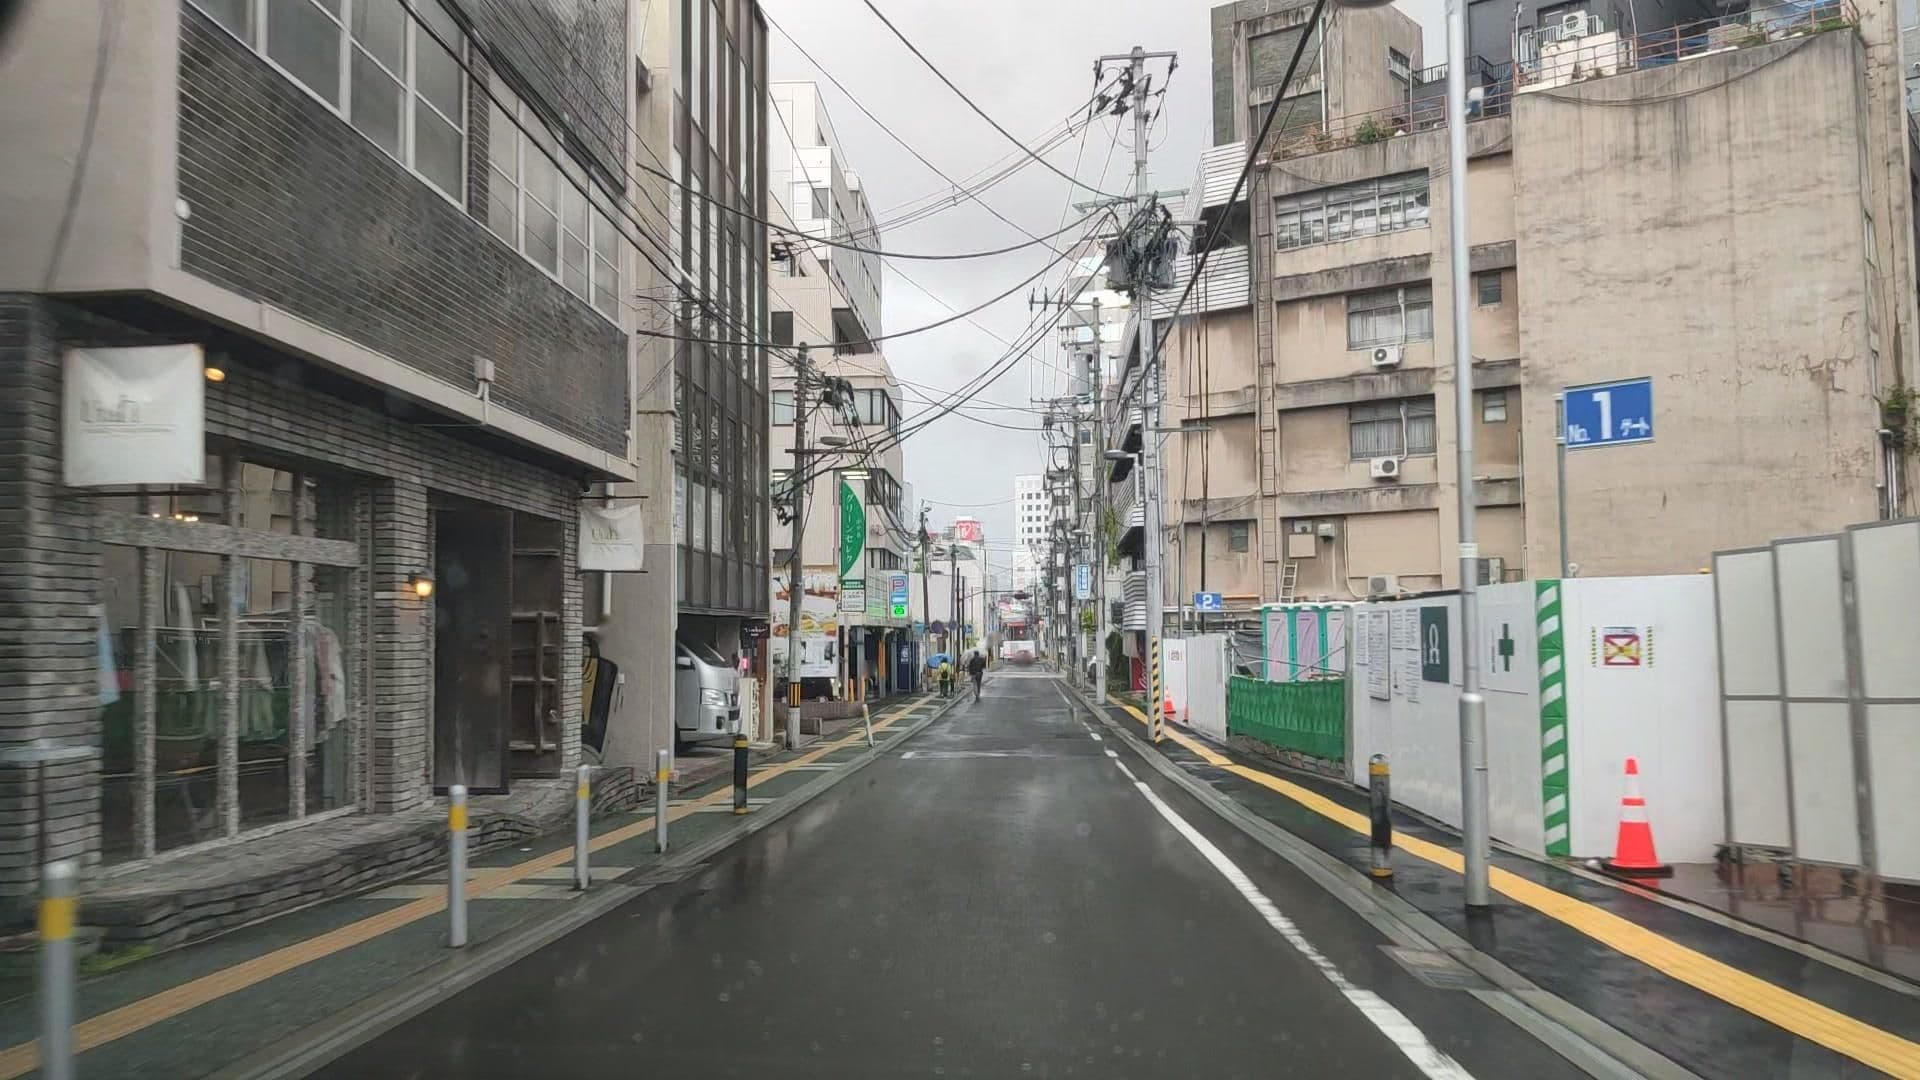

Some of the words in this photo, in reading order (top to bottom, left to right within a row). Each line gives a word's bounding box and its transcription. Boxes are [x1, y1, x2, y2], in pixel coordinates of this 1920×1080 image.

[1592, 391, 1612, 439] 1
[892, 578, 905, 592] P
[1202, 594, 1213, 609] 2
